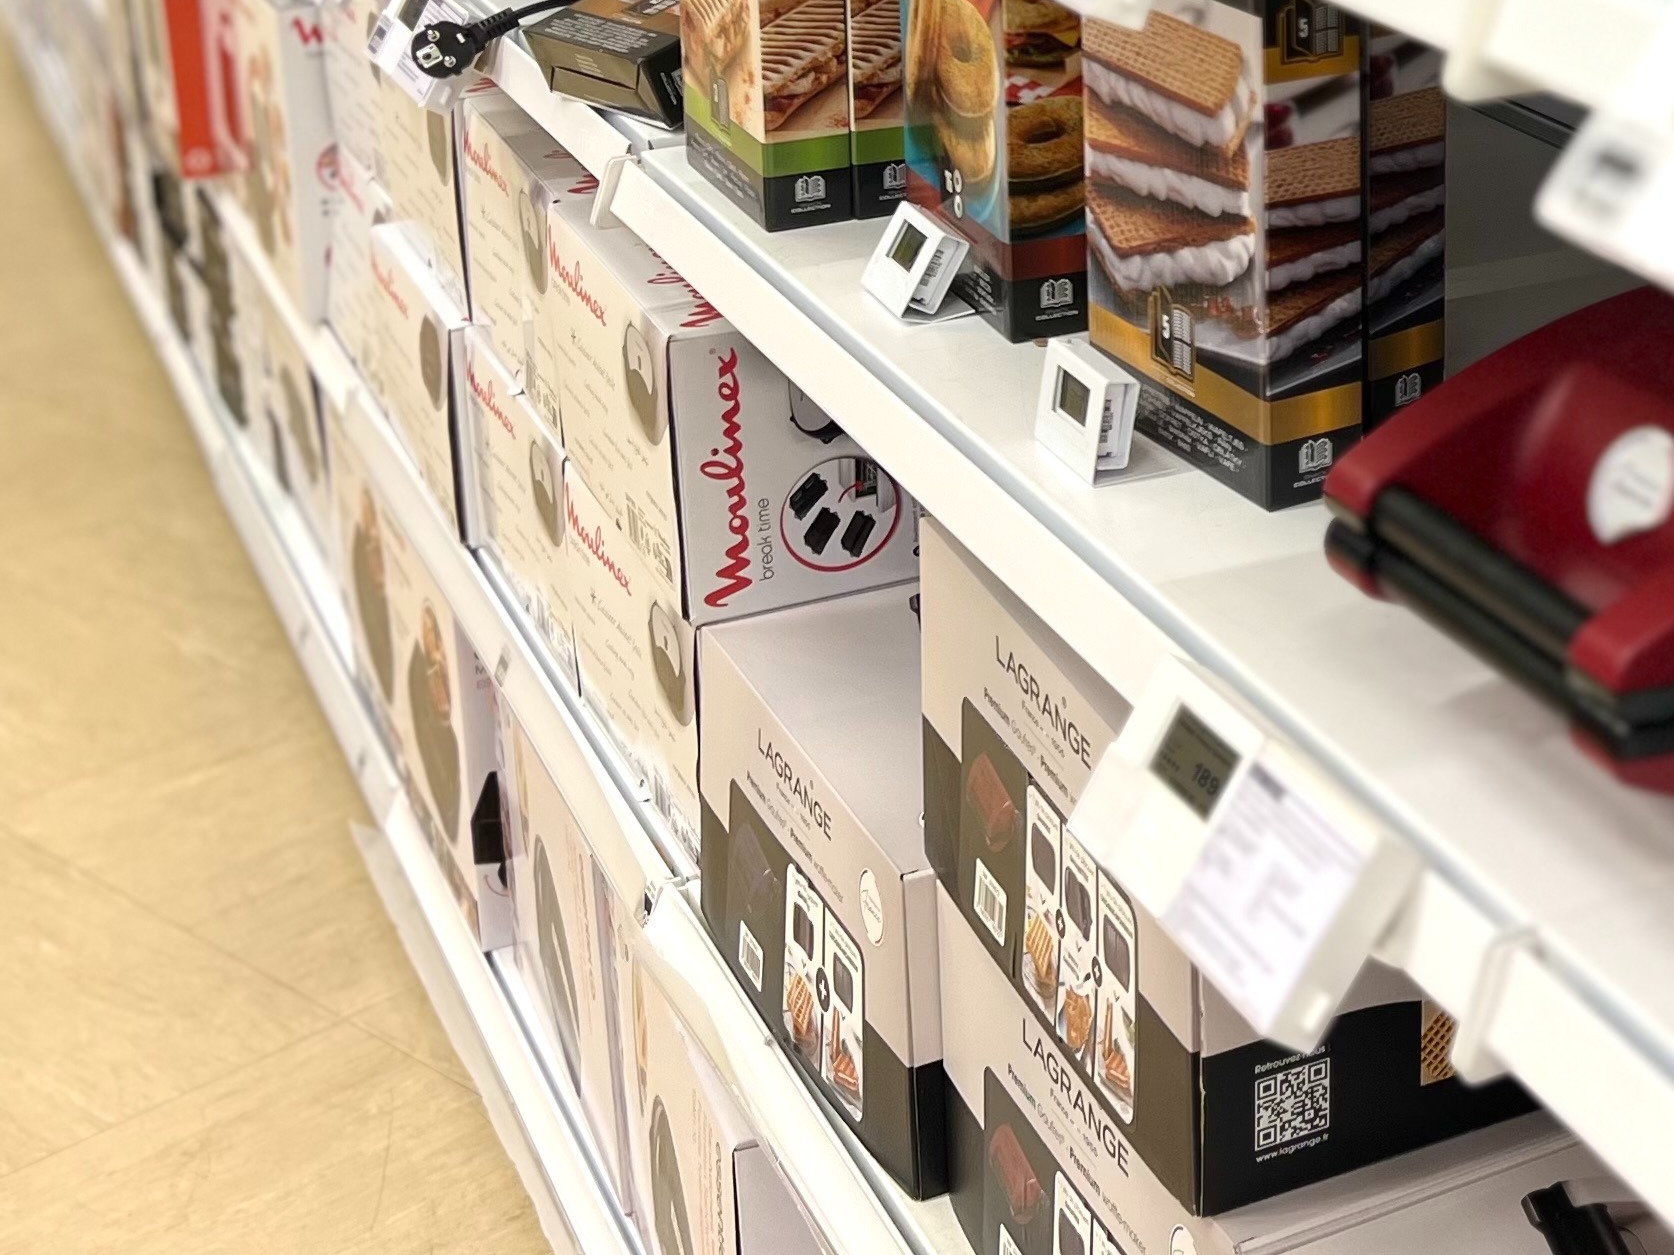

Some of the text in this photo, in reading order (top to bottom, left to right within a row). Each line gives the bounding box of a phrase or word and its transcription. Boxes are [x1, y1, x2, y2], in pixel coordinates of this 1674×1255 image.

[547, 224, 607, 327] Moulinex
[466, 360, 516, 440] Moulinex
[700, 346, 753, 608] Moulinex
[565, 481, 632, 597] Moulinex
[757, 496, 775, 582] break time
[995, 634, 1092, 771] LAGRANGE
[757, 727, 832, 842] LAGRANGE
[1022, 1017, 1129, 1179] LAGRANGE
[1255, 1132, 1330, 1163] www.lagrange.fr
